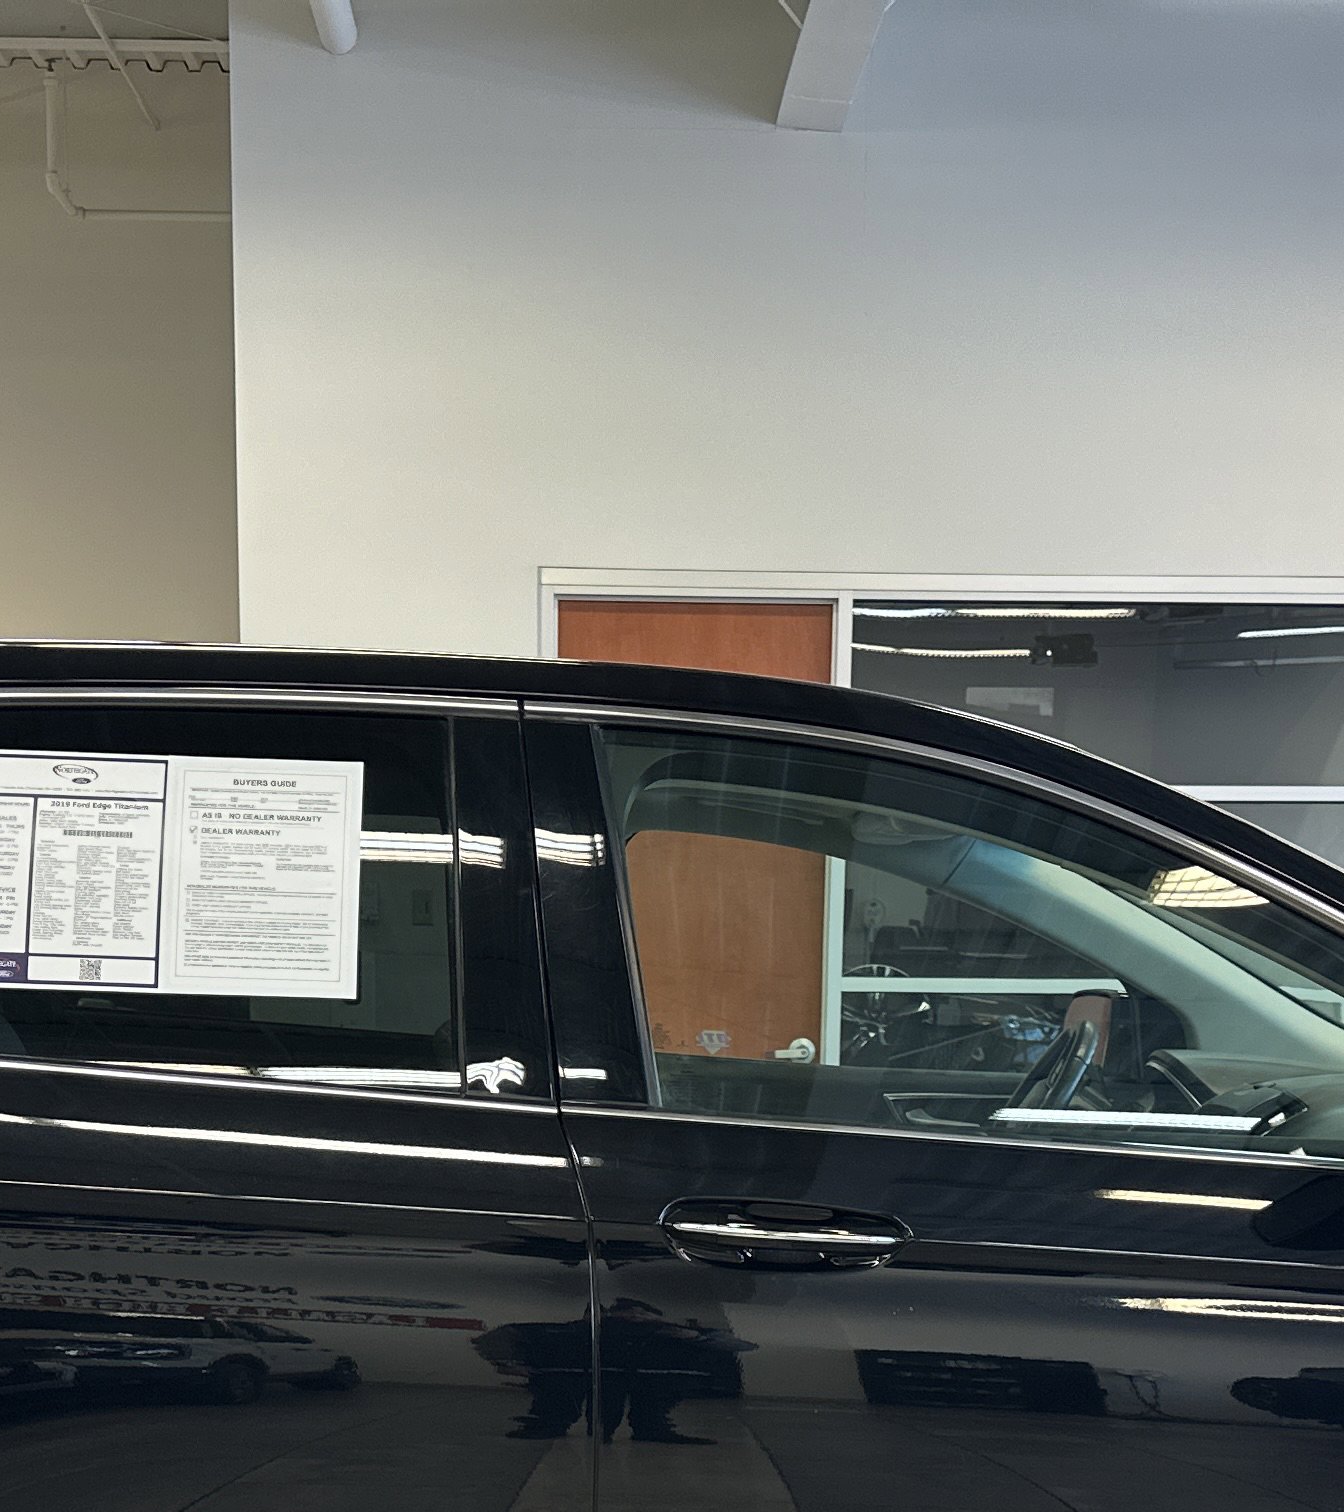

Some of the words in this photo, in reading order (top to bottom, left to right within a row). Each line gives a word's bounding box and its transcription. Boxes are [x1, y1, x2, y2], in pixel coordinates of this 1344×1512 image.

[233, 778, 268, 786] BUYERS
[270, 780, 297, 788] GUIDE
[92, 802, 112, 810] Edge
[277, 814, 322, 822] WARRANTY
[235, 828, 281, 836] WARRANTY
